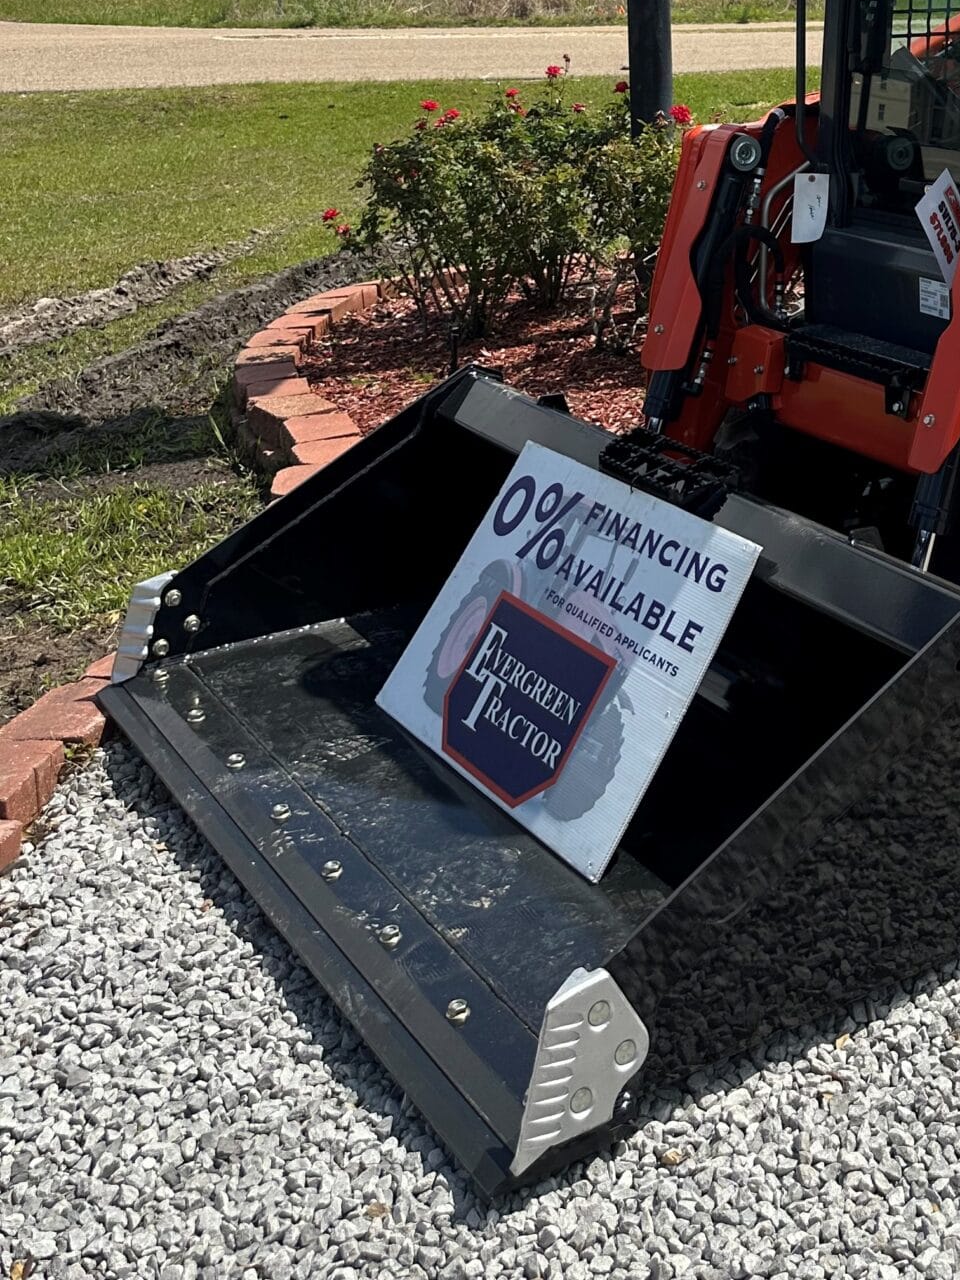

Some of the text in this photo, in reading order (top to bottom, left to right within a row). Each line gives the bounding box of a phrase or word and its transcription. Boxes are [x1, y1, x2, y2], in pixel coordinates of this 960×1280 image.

[493, 475, 585, 570] 0%
[583, 501, 729, 593] FINANCING
[555, 554, 704, 654] AVAILABLE
[565, 602, 615, 638] QUALIFIED
[614, 633, 680, 677] APPLICANTS
[462, 669, 563, 770] TRACTOR
[466, 622, 581, 725] EVERGREEN
